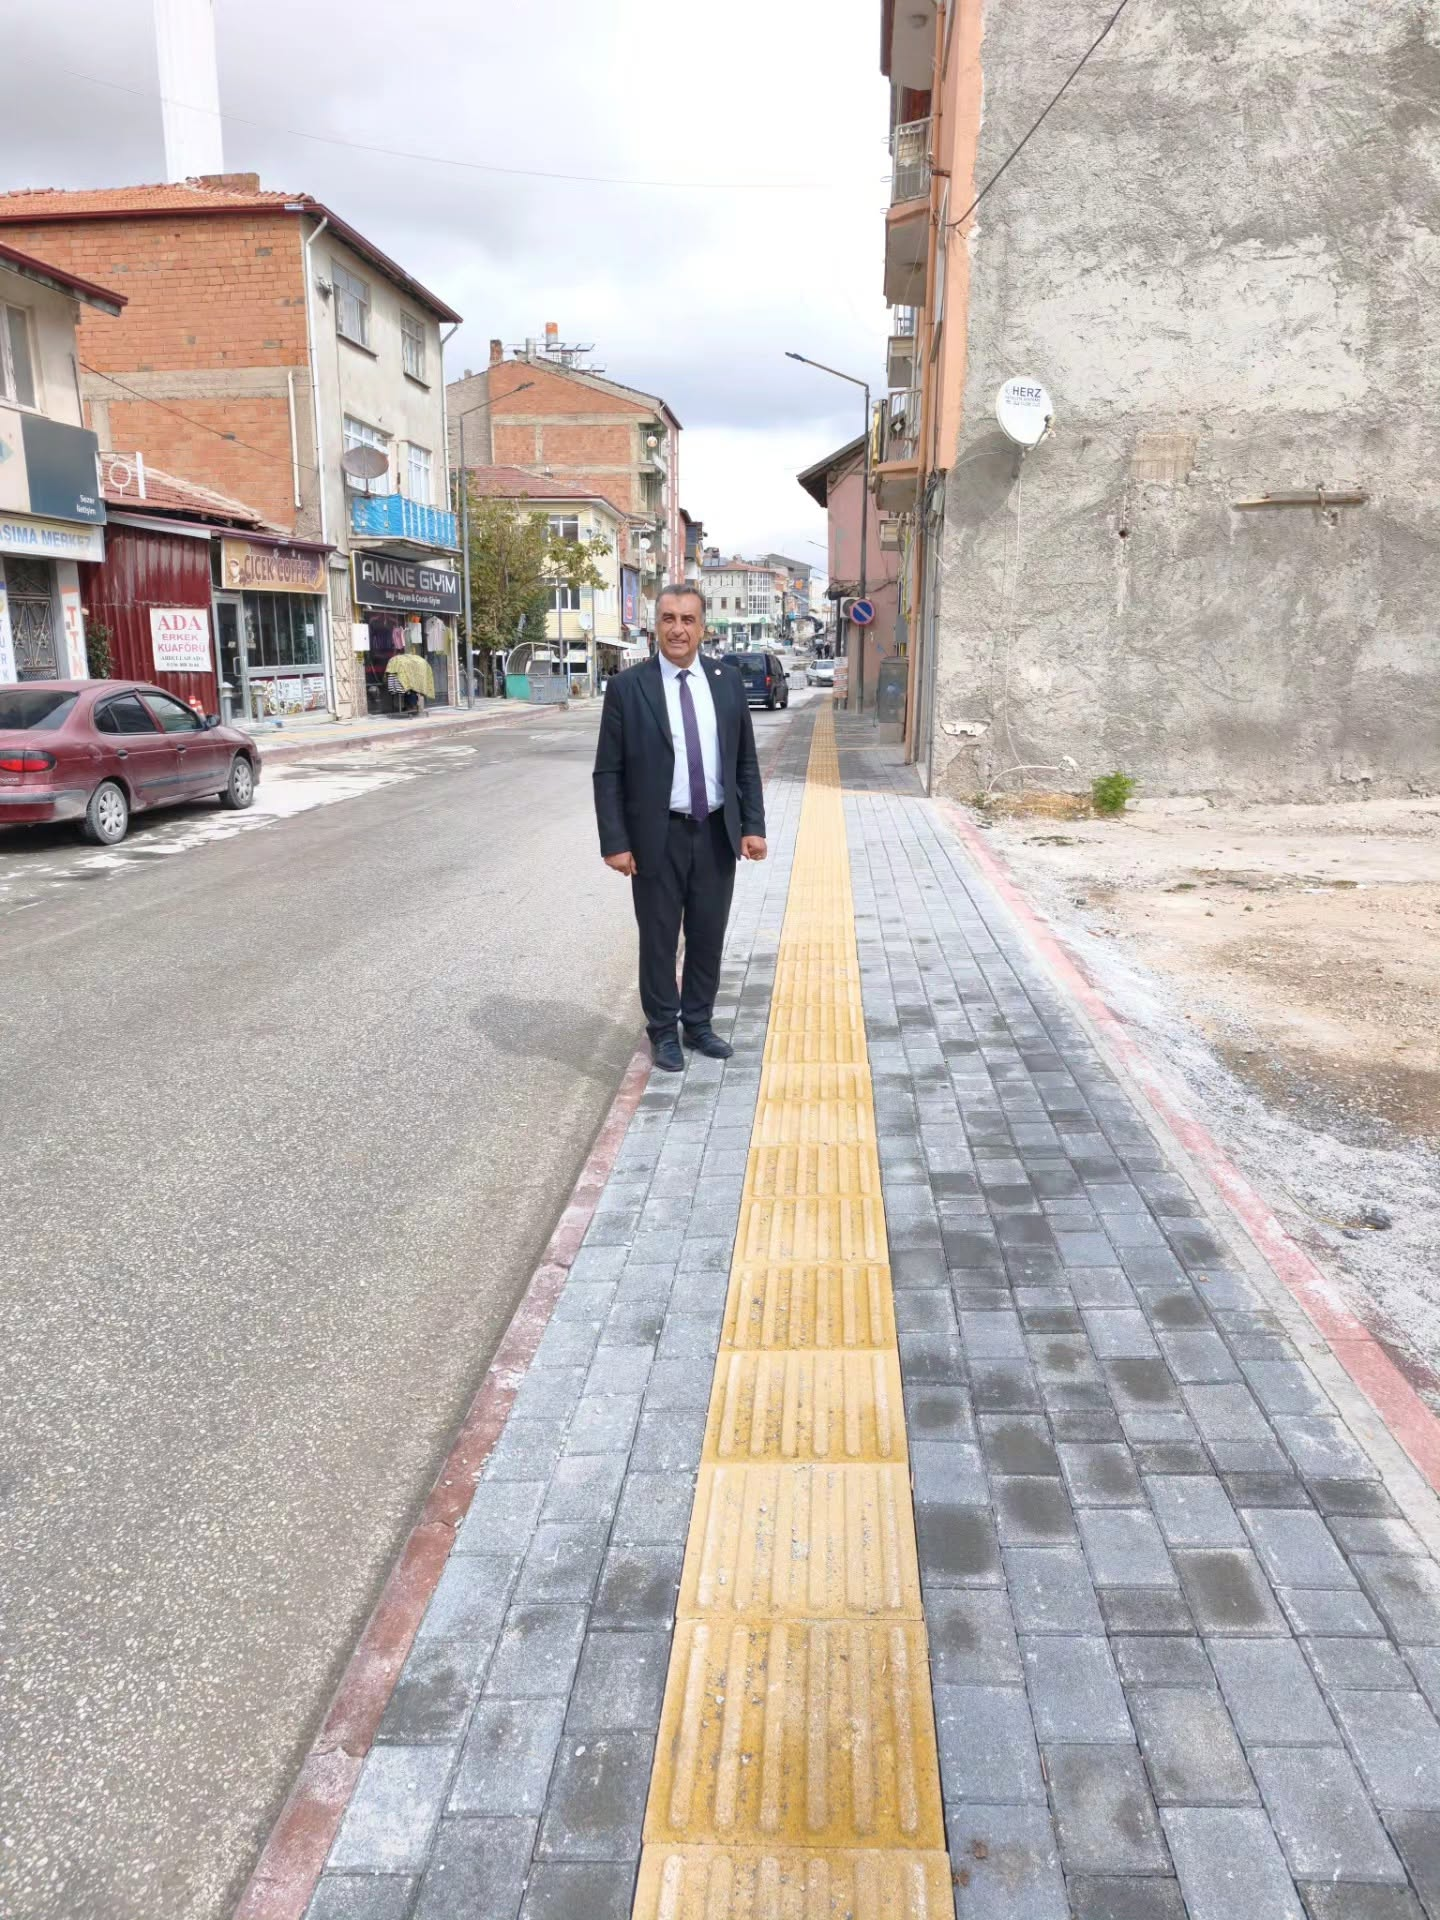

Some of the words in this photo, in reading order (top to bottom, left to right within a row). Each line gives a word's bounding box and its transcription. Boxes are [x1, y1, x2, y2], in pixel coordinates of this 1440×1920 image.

[1012, 385, 1042, 398] HERZ
[158, 614, 202, 631] ADA
[162, 633, 198, 641] ERKEK
